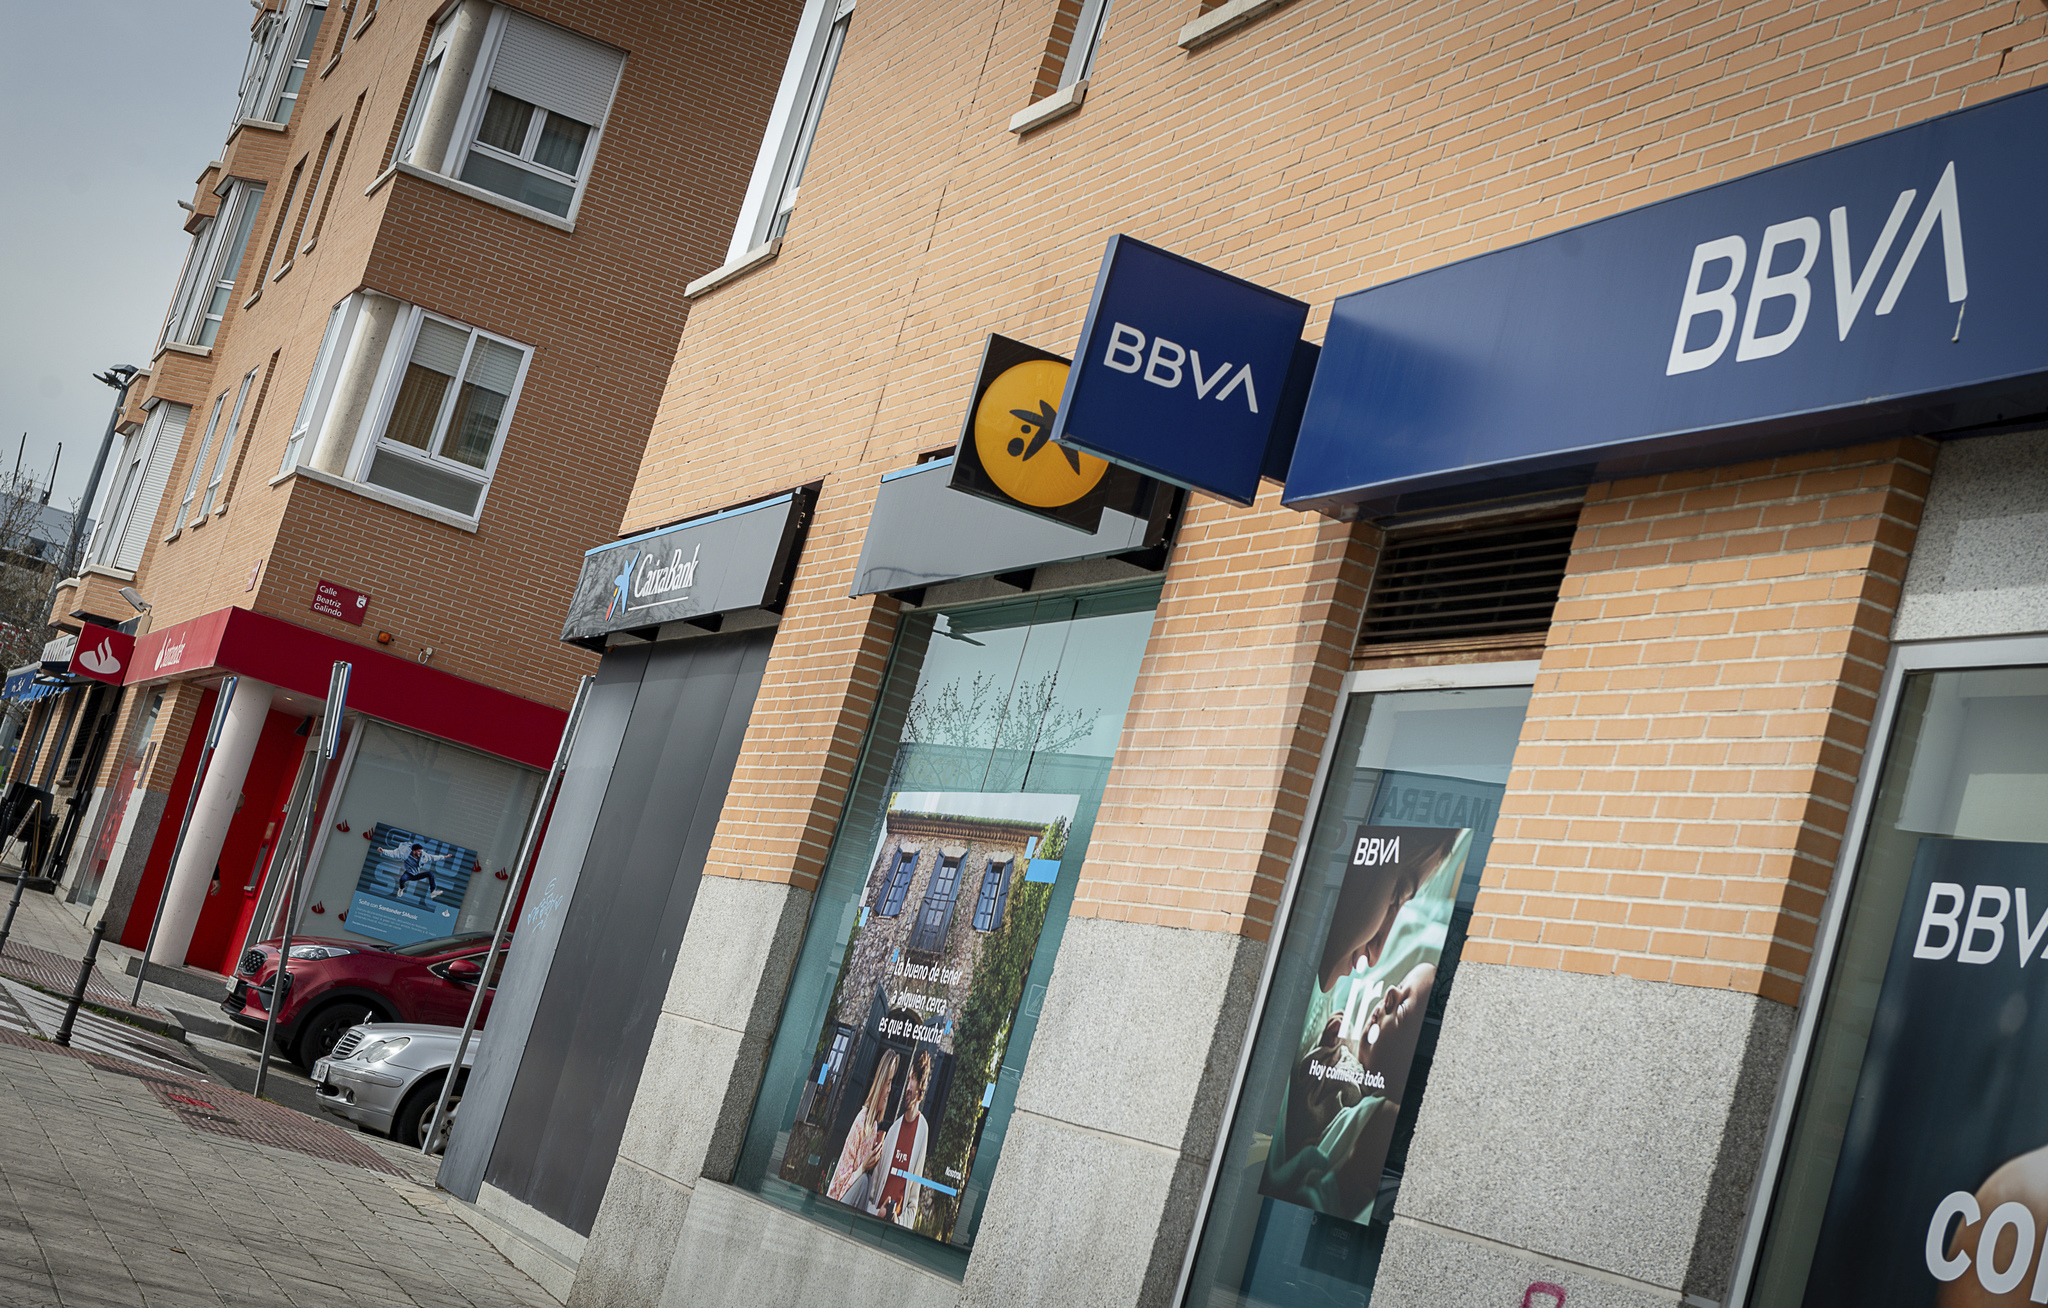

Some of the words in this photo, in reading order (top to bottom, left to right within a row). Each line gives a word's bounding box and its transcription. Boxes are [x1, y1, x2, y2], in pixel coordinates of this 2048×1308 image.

[1665, 160, 1968, 376] BBVA
[1103, 321, 1259, 414] BBVA
[634, 543, 701, 598] CaixaBank
[316, 594, 342, 608] Beatriz
[319, 585, 338, 596] Calle
[313, 602, 342, 617] Galindo
[1352, 835, 1400, 866] BBVA
[1912, 881, 2048, 969] BBV
[893, 957, 904, 976] Lo
[903, 957, 929, 980] bueno
[928, 961, 941, 982] de
[940, 966, 963, 985] tener
[891, 990, 898, 1004] a
[897, 986, 927, 1012] alguien
[926, 996, 947, 1016] cerca
[1337, 954, 1385, 1045] ir.
[878, 1017, 889, 1032] es
[887, 1018, 904, 1039] que
[902, 1019, 912, 1038] te
[911, 1022, 944, 1044] escucha
[1308, 1059, 1327, 1081] Hoy
[1325, 1066, 1364, 1085] comienza
[1363, 1070, 1386, 1089] todo.
